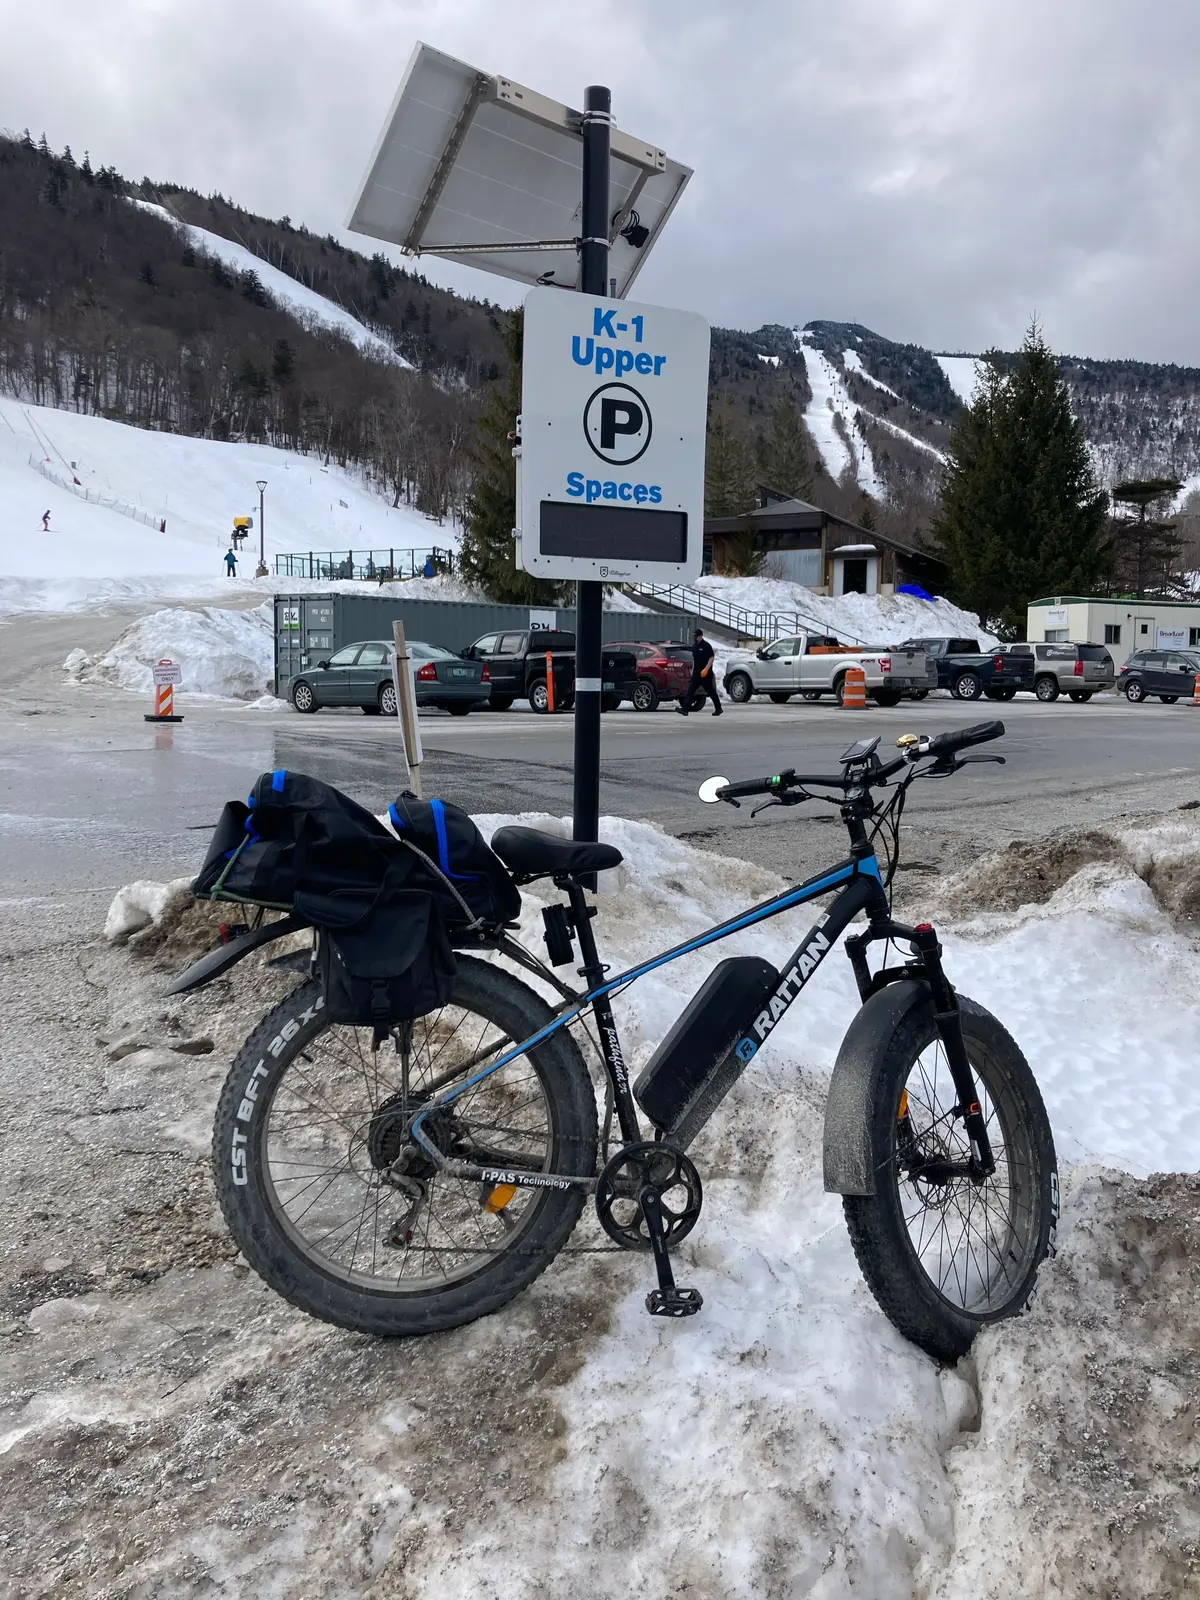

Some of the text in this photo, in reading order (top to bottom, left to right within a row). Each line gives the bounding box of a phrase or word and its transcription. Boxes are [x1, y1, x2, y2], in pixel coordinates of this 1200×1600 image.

[593, 307, 644, 343] K-1
[571, 335, 667, 378] Upper
[600, 397, 643, 449] P
[565, 471, 663, 504] Spaces
[752, 931, 831, 1040] RATTAN
[236, 1058, 270, 1123] BFT
[231, 1127, 248, 1186] CST
[518, 1175, 571, 1189] Technology
